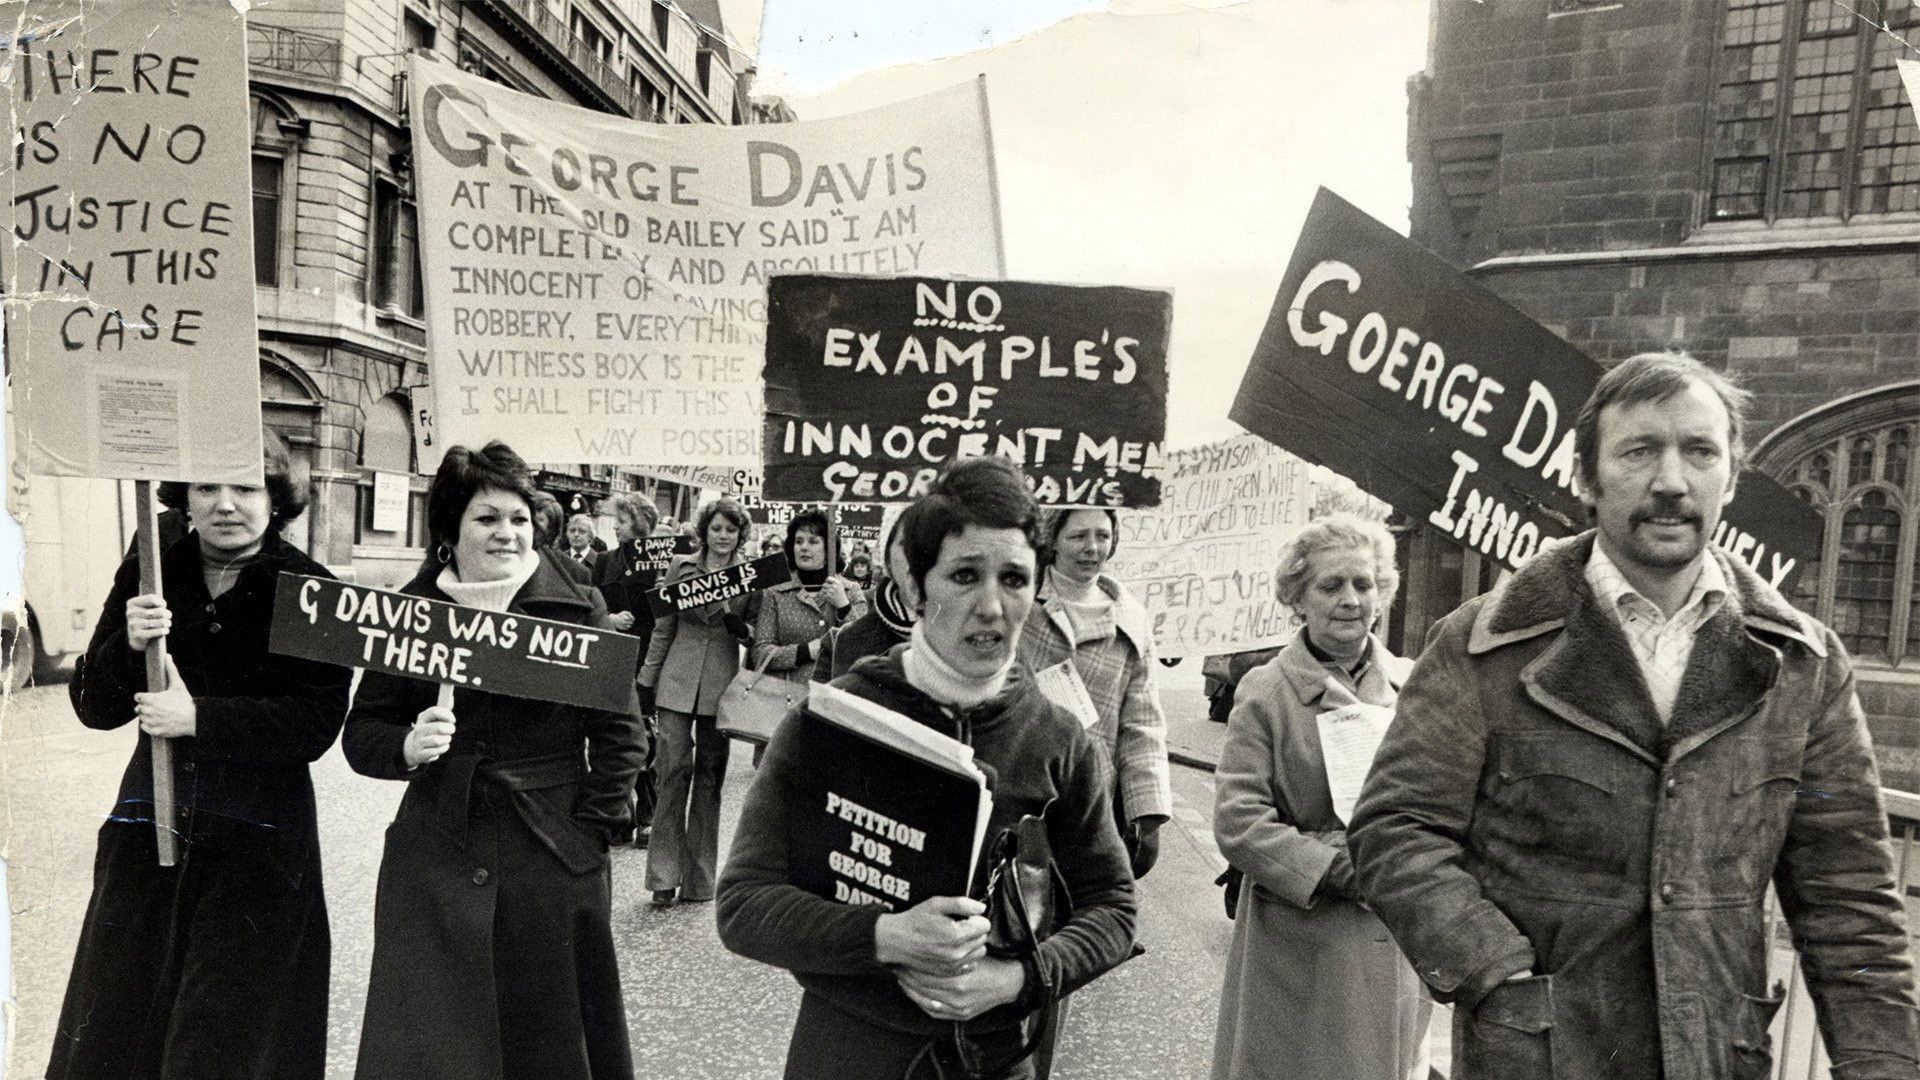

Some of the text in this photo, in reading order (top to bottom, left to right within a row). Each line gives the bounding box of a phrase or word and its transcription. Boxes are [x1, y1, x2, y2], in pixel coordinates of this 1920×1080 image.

[20, 44, 199, 101] THERE
[16, 121, 205, 170] IS NO
[423, 84, 926, 208] GEORGE DAVIS
[451, 180, 490, 209] AT
[509, 184, 564, 217] THE
[582, 209, 629, 238] OLD
[647, 217, 745, 247] BAILEY
[759, 218, 828, 247] SAID
[875, 205, 916, 239] AM
[40, 248, 218, 291] IN THIS
[450, 221, 649, 274] COMPLETEY
[669, 257, 725, 285] AND
[450, 267, 603, 299] INNOCENT
[624, 275, 653, 301] OF
[915, 282, 1002, 325] NO
[60, 304, 203, 351] CASE
[453, 308, 574, 341] ROBBERY,
[458, 349, 585, 379] WITNESS
[595, 352, 648, 381] BOX
[664, 354, 682, 380] IS
[692, 354, 744, 383] THE
[824, 328, 1140, 385] EXAMPLE'S
[1287, 260, 1505, 437] GOERGE
[460, 385, 479, 415] I
[493, 387, 568, 415] SHALL
[588, 388, 663, 416] FIGHT
[676, 390, 729, 416] THIS
[927, 381, 999, 421] OF
[575, 428, 637, 456] WAY
[783, 420, 1063, 468] INNOCENT
[1072, 431, 1166, 479] MEN
[634, 538, 676, 554] G DAVIS
[648, 549, 674, 561] WAS
[660, 562, 757, 603] G DAVIS IS
[677, 580, 756, 610] INNOCENT.
[300, 579, 599, 664] G DAVIS WAS NOT
[357, 626, 482, 686] THERE.
[825, 791, 926, 852] PETITION
[850, 831, 892, 867] FOR
[828, 850, 911, 901] GEORGE
[835, 880, 894, 911] DAV
